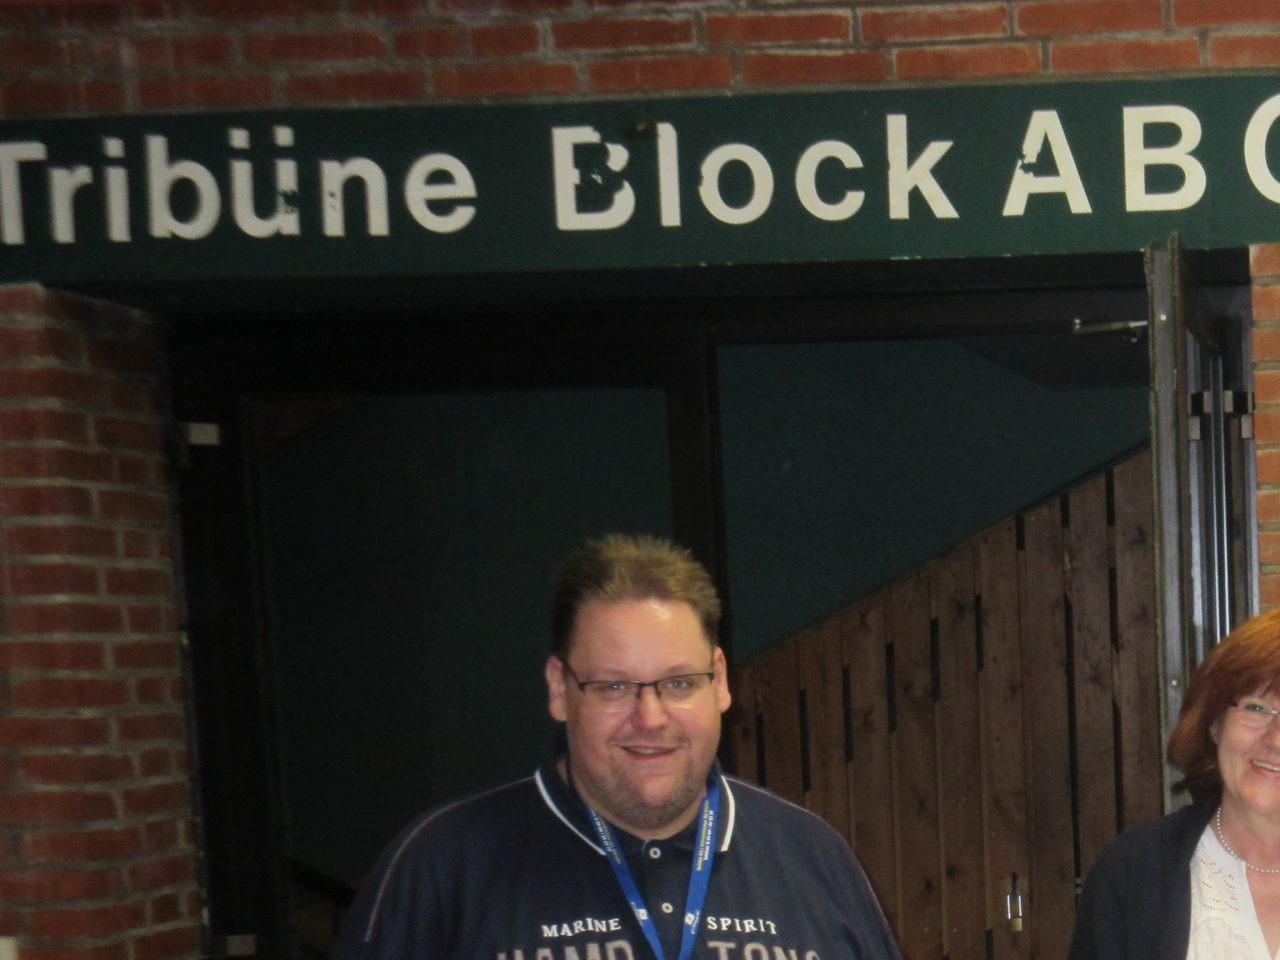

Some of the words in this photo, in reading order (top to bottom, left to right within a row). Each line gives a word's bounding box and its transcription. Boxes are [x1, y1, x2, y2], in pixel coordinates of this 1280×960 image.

[0, 126, 478, 245] Tribüne
[551, 114, 959, 231] Block
[1002, 110, 1093, 216] A
[1122, 105, 1207, 213] B
[541, 915, 622, 939] MARINE
[706, 915, 778, 936] SPIRIT
